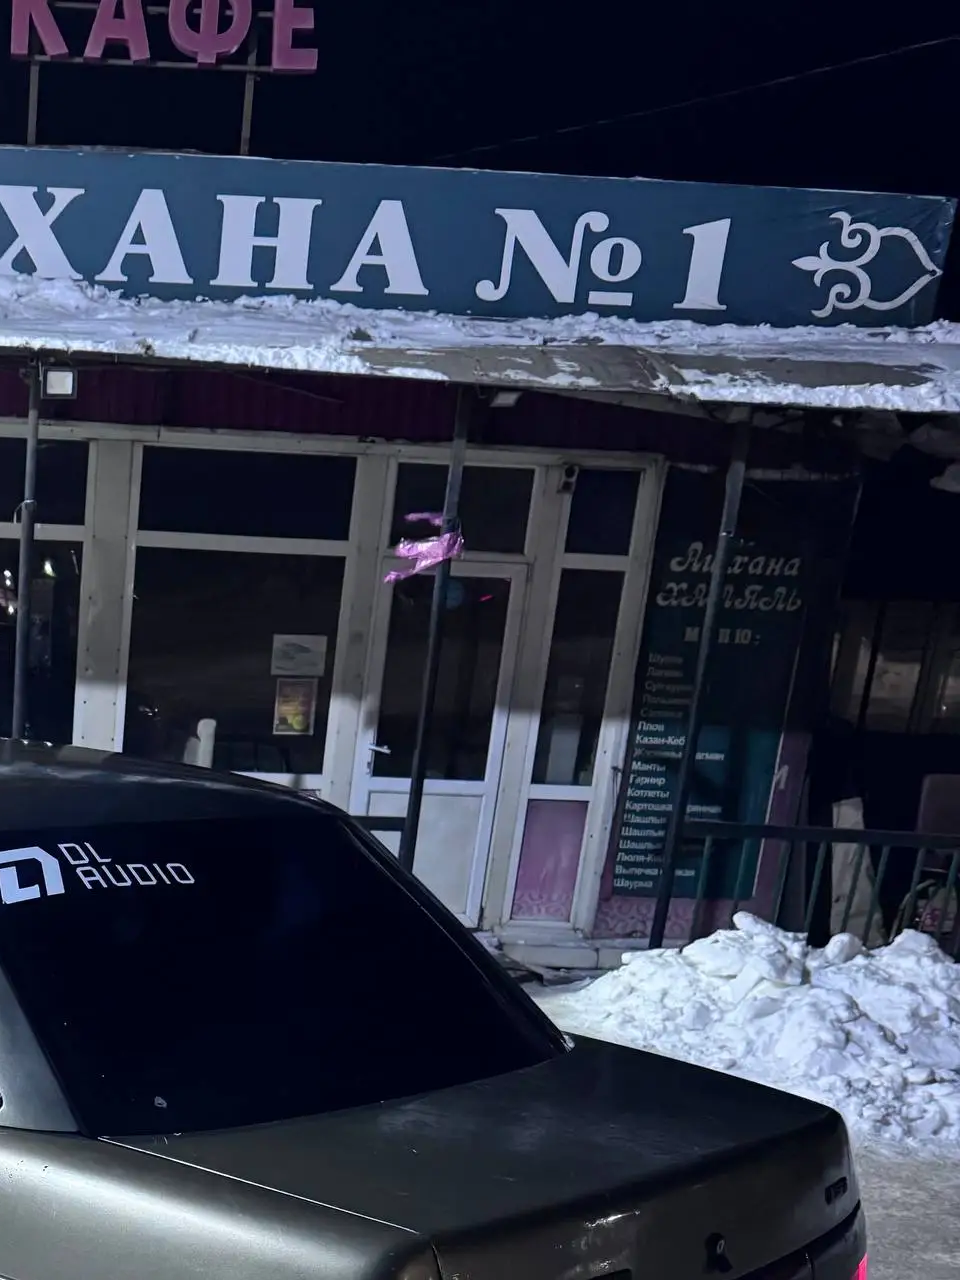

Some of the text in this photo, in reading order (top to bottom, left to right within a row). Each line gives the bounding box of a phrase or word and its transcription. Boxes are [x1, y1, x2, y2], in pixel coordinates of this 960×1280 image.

[10, 0, 319, 71] КАФЕ
[474, 207, 642, 307] №
[672, 217, 732, 311] 1
[631, 760, 667, 772] Манты
[629, 773, 667, 787] Гарнир
[626, 787, 671, 799] Котлеты
[57, 841, 112, 866] DL
[75, 862, 196, 890] AUDIO
[613, 878, 654, 890] Шаурма
